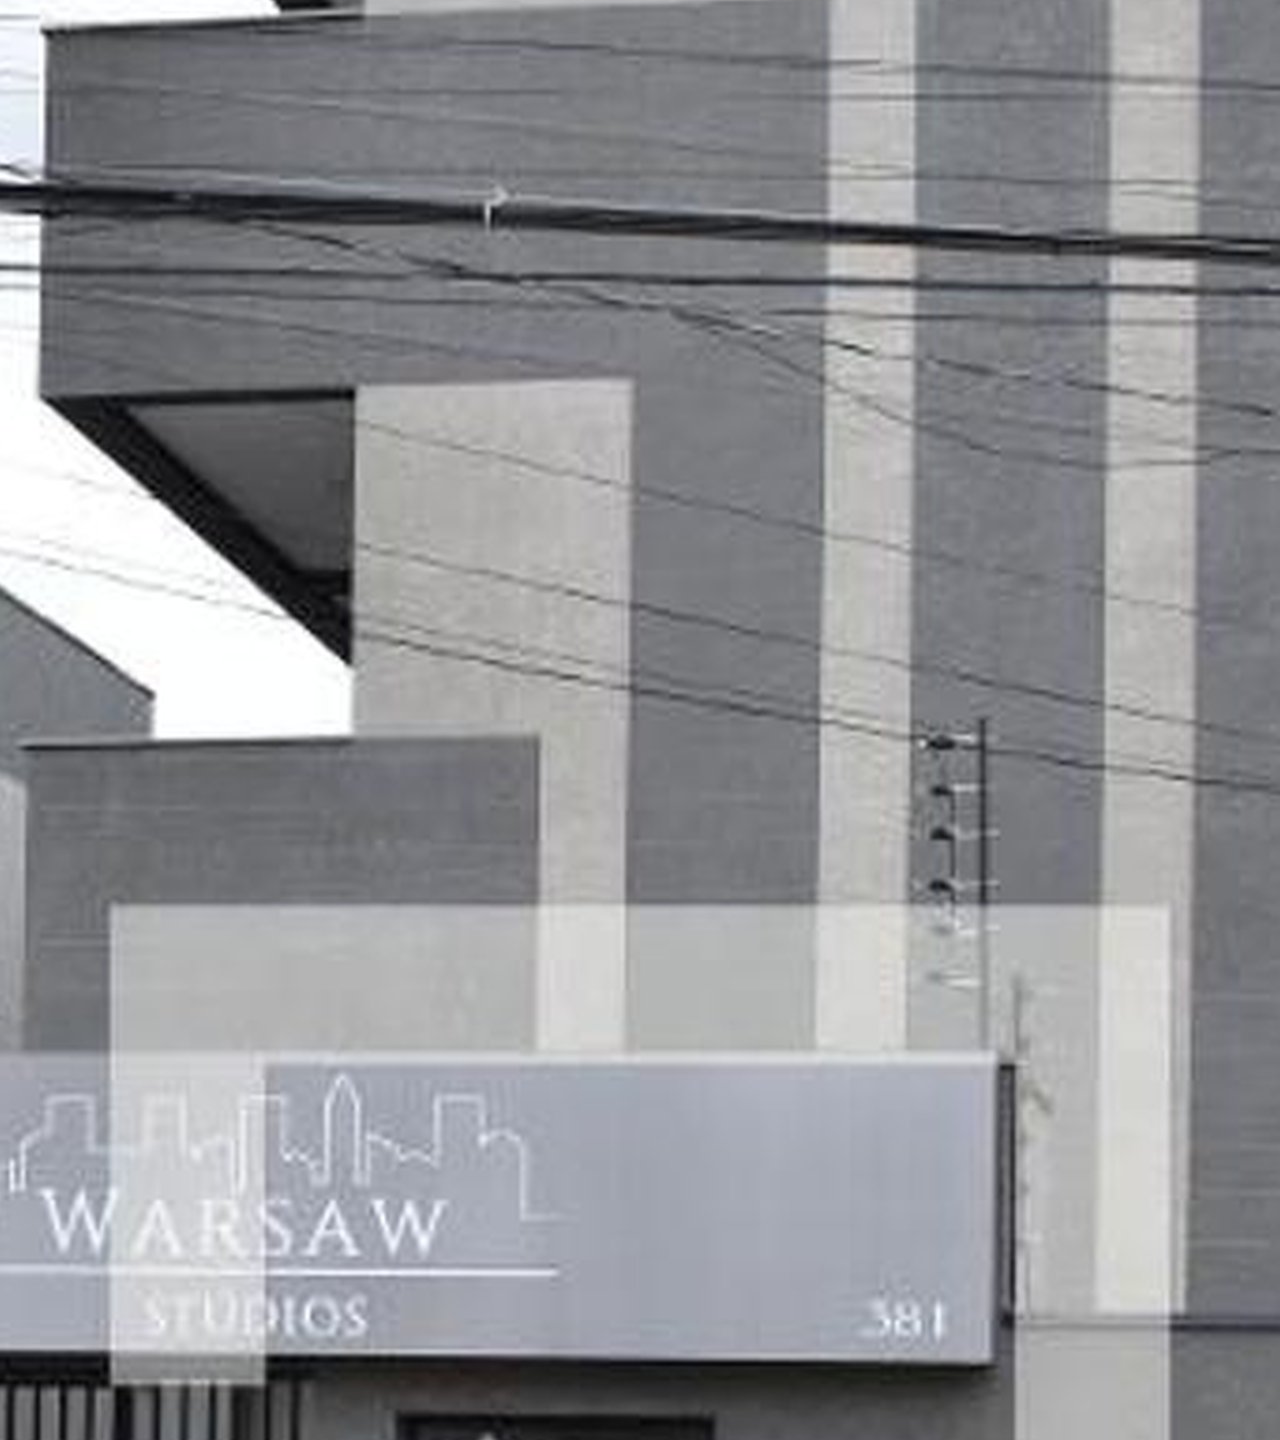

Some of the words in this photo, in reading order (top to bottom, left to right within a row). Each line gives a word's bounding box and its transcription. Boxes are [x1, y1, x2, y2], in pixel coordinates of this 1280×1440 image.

[39, 1188, 448, 1257] WARSAW
[146, 1293, 369, 1338] STUDIOS
[858, 1298, 945, 1341] 381
